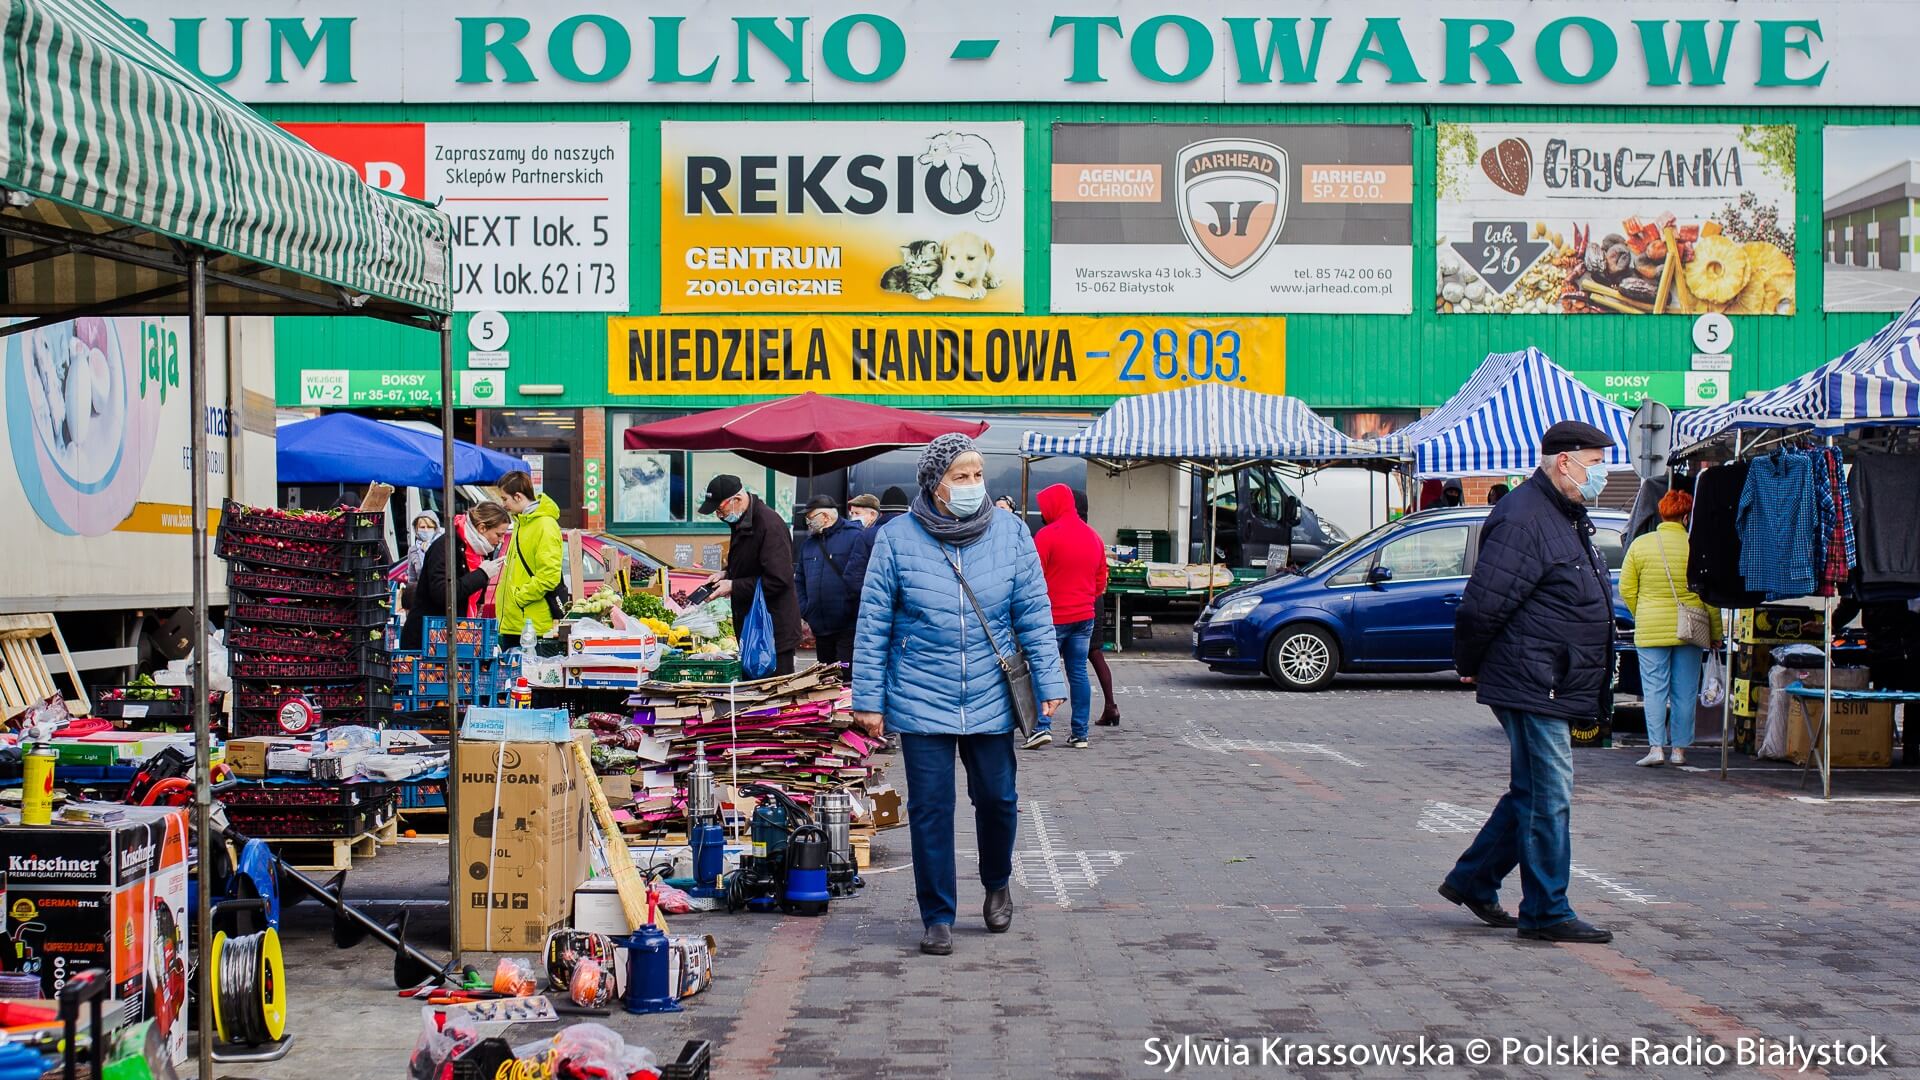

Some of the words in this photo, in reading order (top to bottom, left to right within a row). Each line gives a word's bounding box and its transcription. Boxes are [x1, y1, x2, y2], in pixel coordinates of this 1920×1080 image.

[125, 17, 358, 86] UM
[455, 14, 906, 86] ROLNO
[950, 40, 1000, 61] -
[1049, 15, 1829, 87] TOWAROWE
[436, 146, 525, 164] Zapraszamy
[532, 146, 547, 160] do
[555, 146, 614, 164] naszych
[1191, 153, 1274, 175] JARHEAD
[447, 169, 505, 187] Sklepów
[513, 169, 602, 183] Partnerskich
[1080, 170, 1153, 182] AGENCJA
[1311, 170, 1385, 184] JARHEAD
[685, 154, 987, 216] REKSIO
[1079, 183, 1154, 196] OCHRONY
[1314, 185, 1337, 197] SP.
[1340, 185, 1348, 197] Z
[1353, 185, 1383, 198] O.O.
[534, 216, 580, 246] lok.
[594, 216, 608, 246] 5
[1485, 225, 1517, 243] lok.
[685, 247, 842, 269] CENTRUM
[1481, 244, 1521, 275] 26
[453, 263, 483, 295] UX
[576, 262, 582, 295] i
[591, 264, 615, 293] 73
[1076, 268, 1151, 278] Warszawska
[1156, 268, 1169, 278] 43
[1174, 268, 1201, 278] lok.3
[1295, 269, 1312, 278] tel.
[1317, 269, 1330, 278] 85
[1334, 269, 1355, 278] 742
[1359, 269, 1373, 279] 00
[1378, 269, 1392, 279] 60
[686, 279, 842, 296] ZOOLOGICZNE
[1076, 282, 1115, 292] 15-062
[1120, 282, 1174, 294] Białystok
[1271, 283, 1392, 295] www.jarhead.com.pl
[483, 322, 493, 339] 5
[1707, 325, 1718, 342] 5
[140, 317, 179, 407] jaja
[629, 328, 830, 381] NIEDZIELA
[852, 329, 1076, 382] HANDLOWA
[1119, 329, 1247, 383] 28.03.
[306, 374, 343, 384] WEJŚCIE
[382, 375, 425, 385] BOKSY
[1606, 376, 1649, 386] BOKSY
[308, 385, 342, 398] W-2
[354, 392, 366, 400] nr
[369, 390, 405, 401] 35-67,
[409, 390, 432, 402] 102,
[1606, 392, 1619, 401] nr
[1622, 391, 1648, 401] 1-34
[1834, 702, 1869, 715] MUST
[462, 773, 540, 784] HURGAN
[551, 778, 577, 797] HURAAN
[9, 855, 99, 872] Krischner
[121, 843, 156, 867] Krischner
